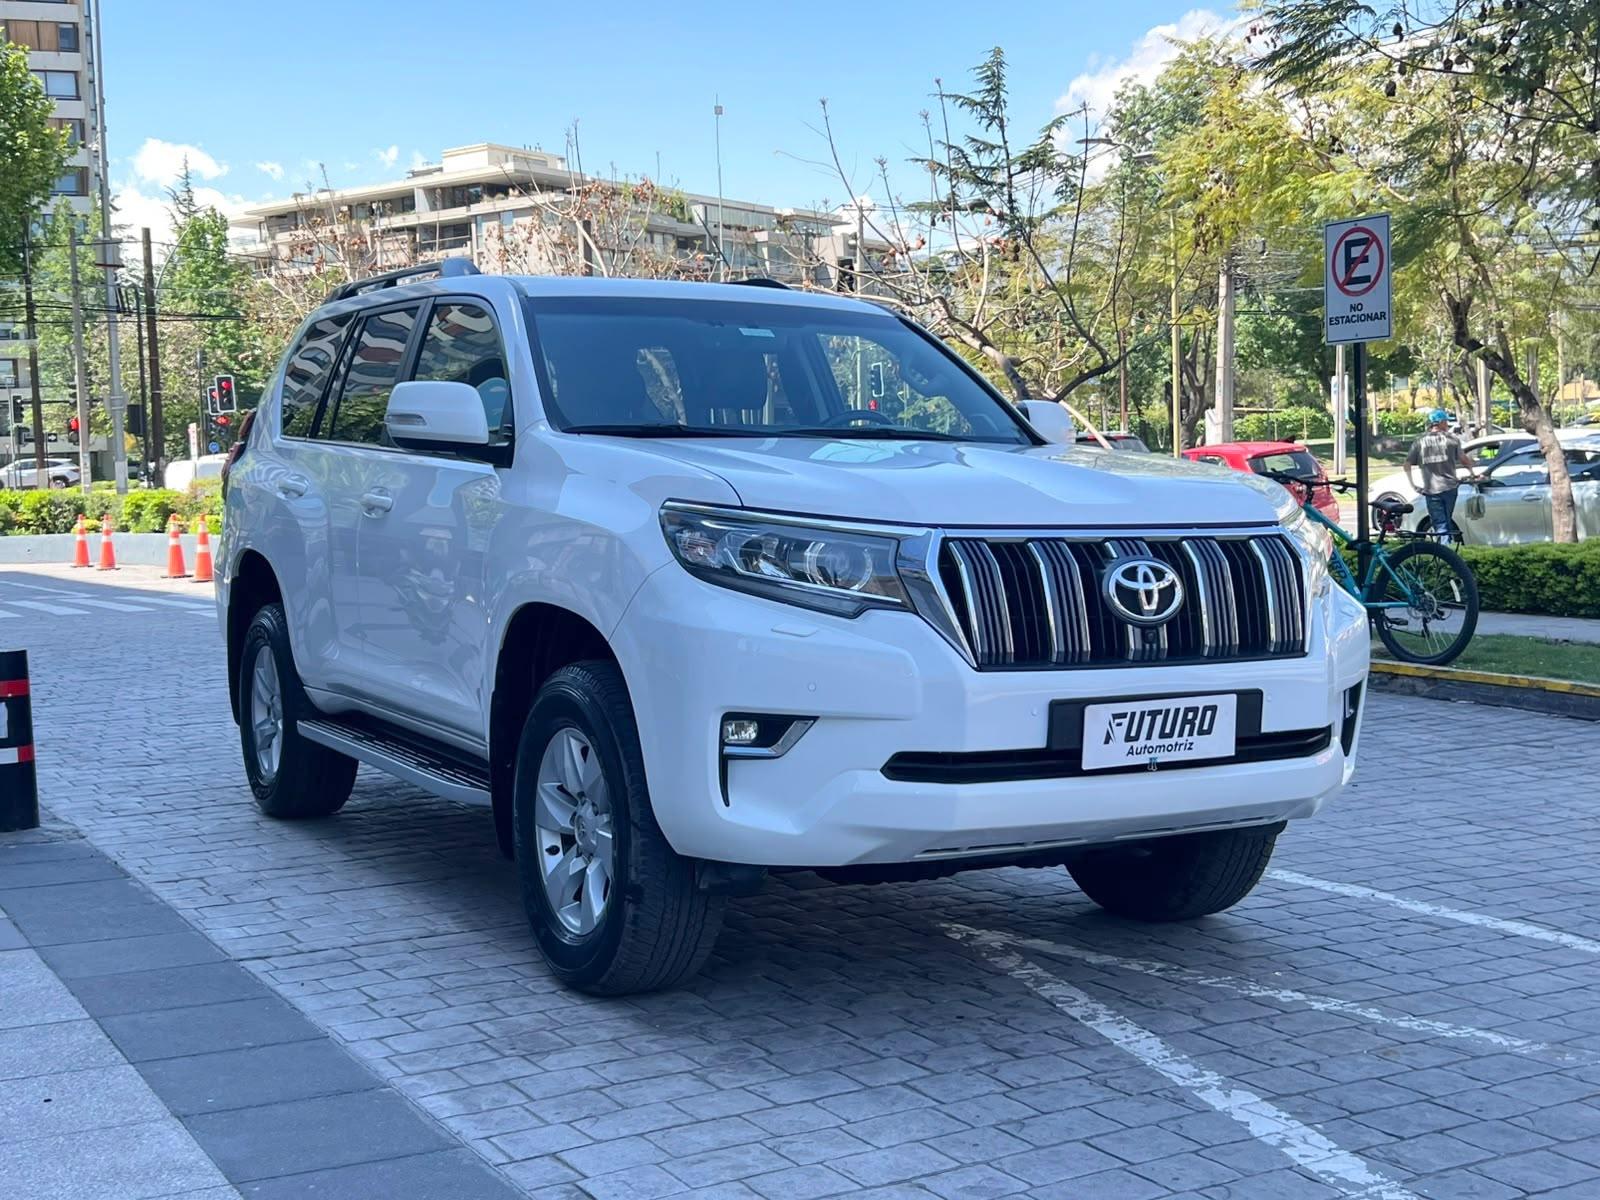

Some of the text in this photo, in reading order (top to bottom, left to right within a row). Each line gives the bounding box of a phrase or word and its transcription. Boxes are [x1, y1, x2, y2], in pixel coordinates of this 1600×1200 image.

[1344, 237, 1371, 286] E
[1349, 302, 1363, 312] NO
[1329, 311, 1386, 326] ESTACIONAR
[1104, 705, 1217, 744] FUTURO
[1126, 739, 1194, 756] Automotriz
